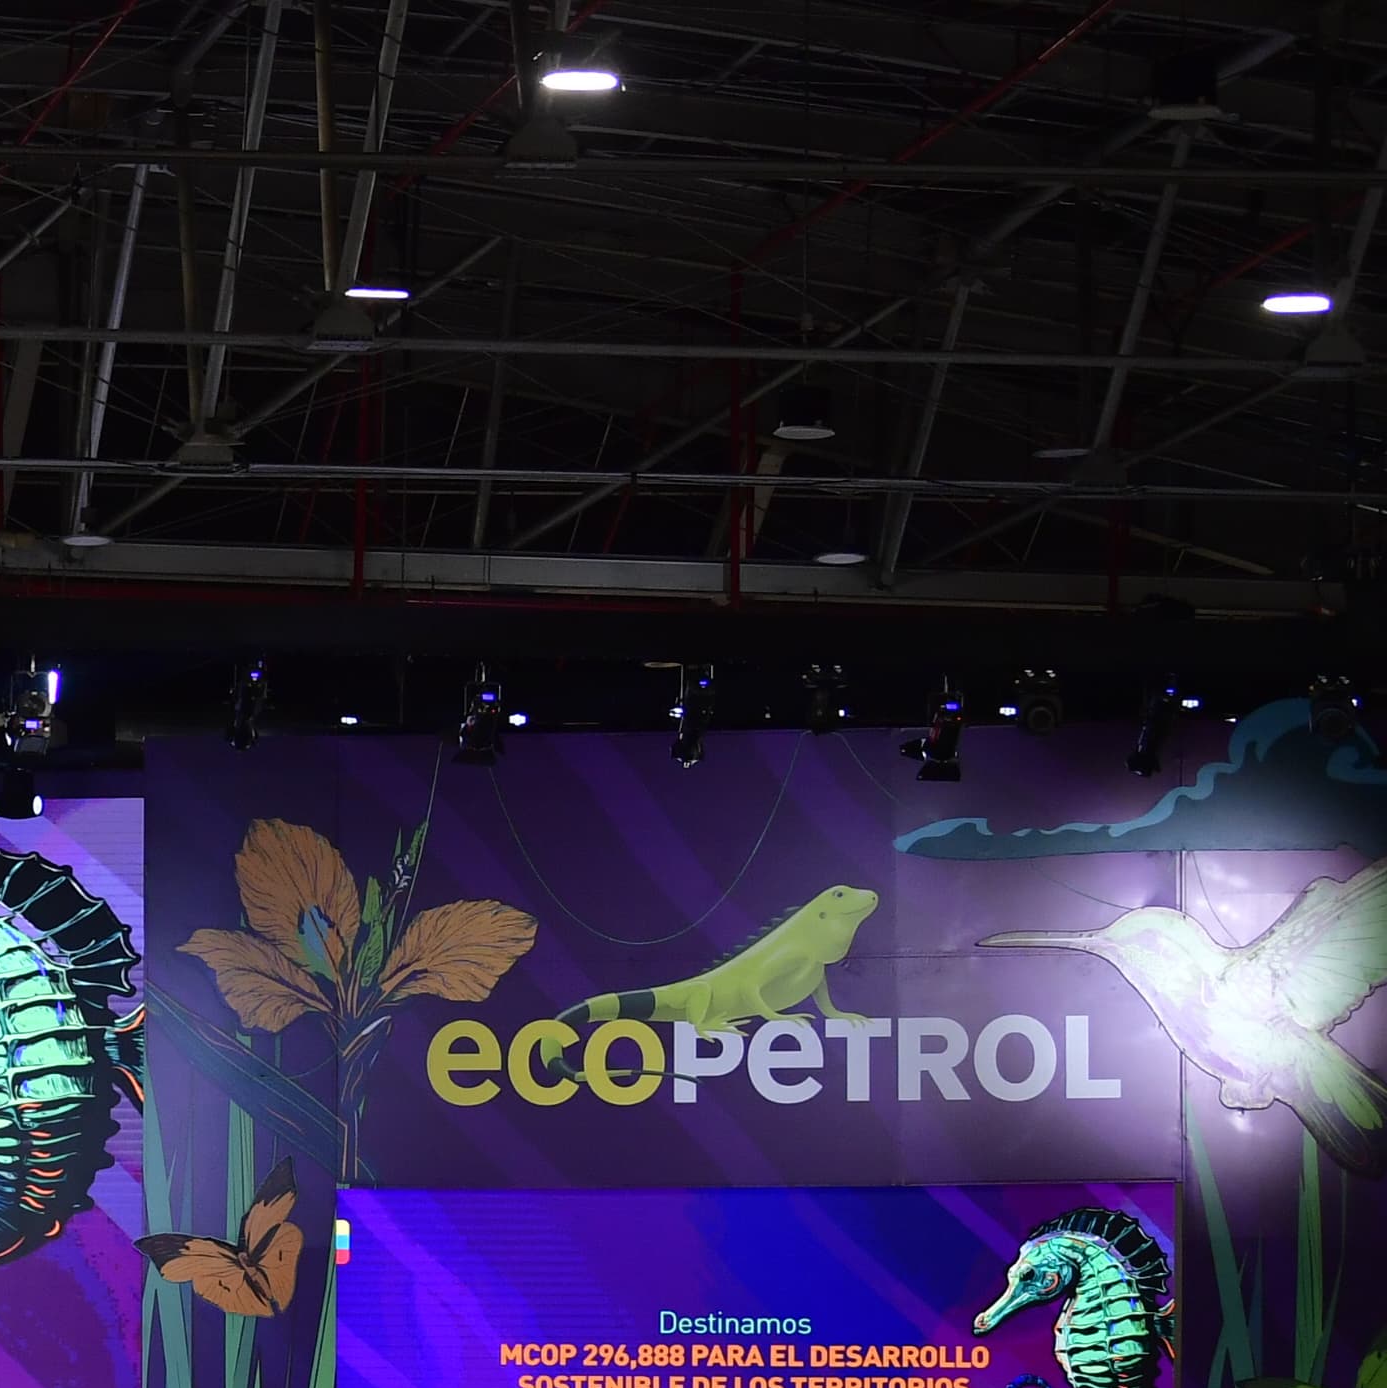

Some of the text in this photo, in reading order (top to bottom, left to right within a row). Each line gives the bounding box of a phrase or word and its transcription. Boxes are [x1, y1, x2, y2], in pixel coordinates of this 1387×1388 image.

[659, 1310, 812, 1335] Destinamos
[500, 1343, 989, 1370] MCOP 296,888 PARA EL DESARROLLO
